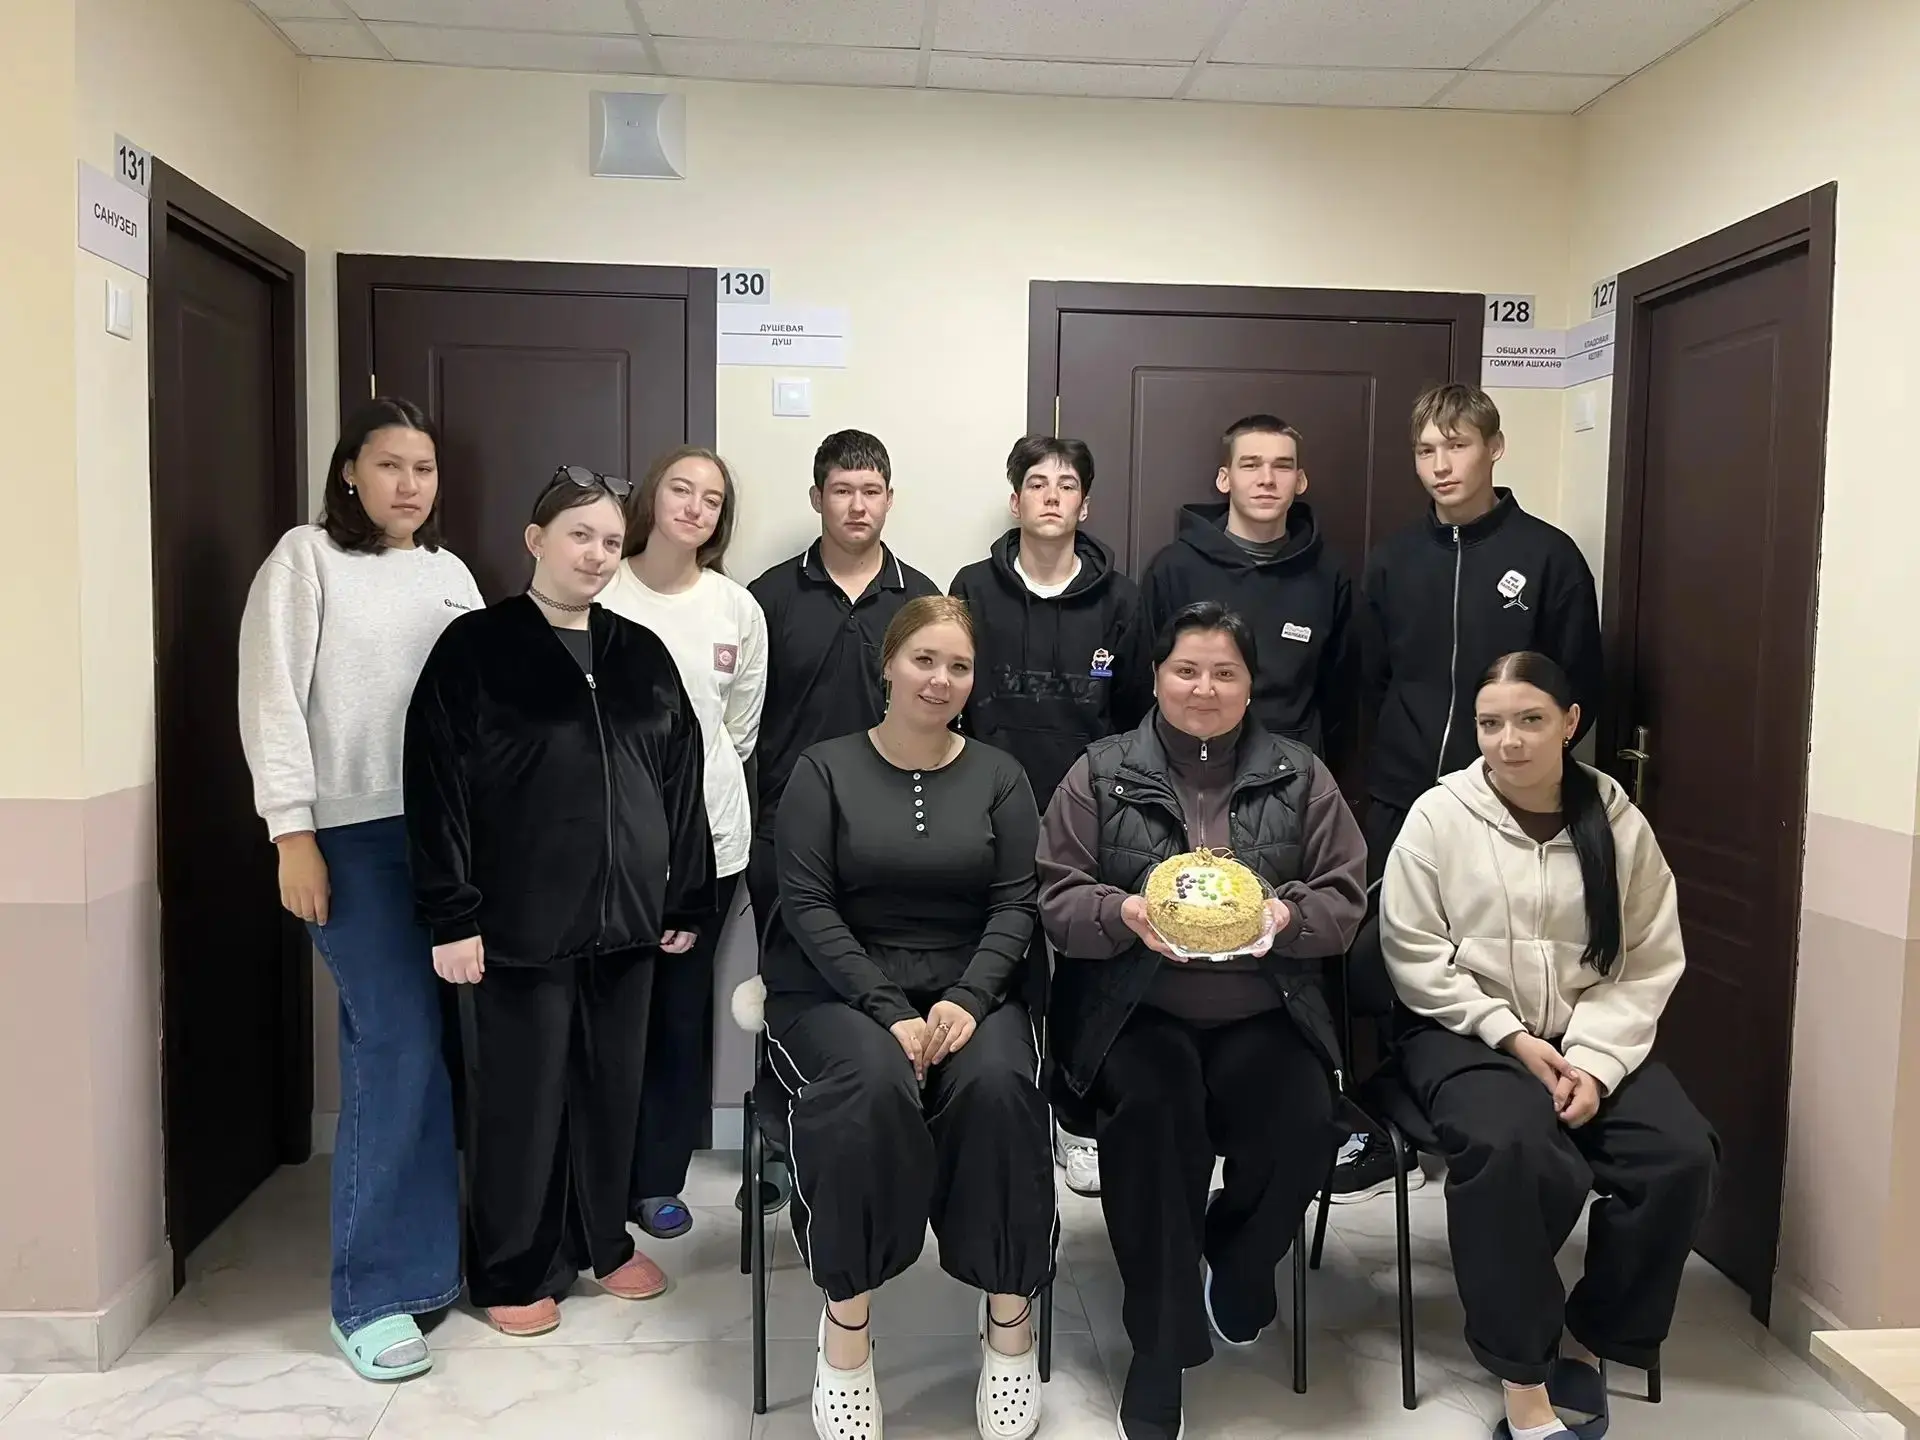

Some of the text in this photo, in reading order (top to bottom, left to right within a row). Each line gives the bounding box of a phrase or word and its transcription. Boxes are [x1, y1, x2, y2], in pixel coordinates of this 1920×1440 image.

[119, 145, 145, 186] 131
[93, 203, 138, 238] САНУЗЕЛ
[720, 272, 764, 295] 130
[1593, 280, 1616, 309] 127
[1489, 300, 1530, 322] 128
[760, 323, 804, 332] ДУШЕВАЯ
[771, 338, 792, 346] ДУШ
[1496, 346, 1556, 355] ОБЩАЯ КУХНЯ
[1489, 359, 1562, 369] ГОМУМИ АШХАНӘ
